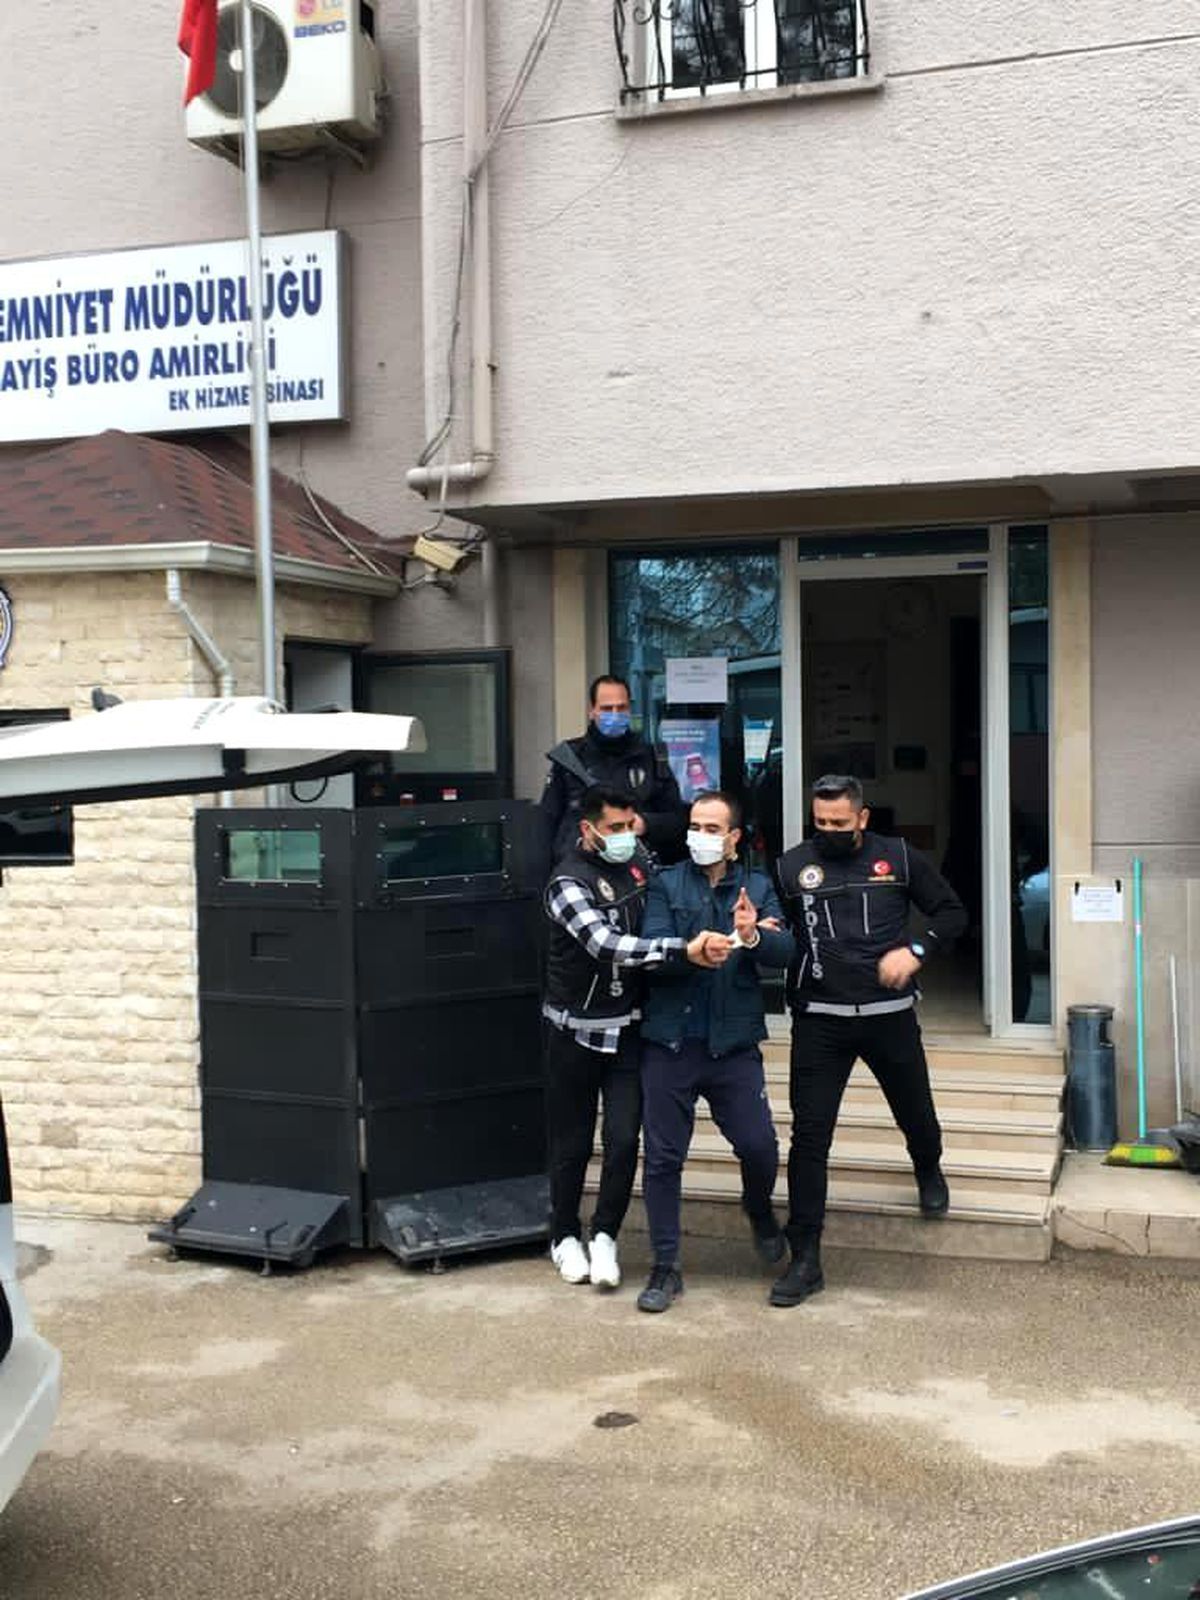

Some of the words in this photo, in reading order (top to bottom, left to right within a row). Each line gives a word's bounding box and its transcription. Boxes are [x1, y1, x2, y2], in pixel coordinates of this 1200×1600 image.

[124, 253, 322, 331] MÜDÜRLÜĞÜ
[0, 348, 58, 398] AYİŞ
[67, 343, 139, 386] BÜRO
[149, 327, 276, 380] AMİRLİİ
[169, 388, 189, 411] EK
[196, 381, 251, 411] HİZME
[265, 375, 324, 403] BİNASI
